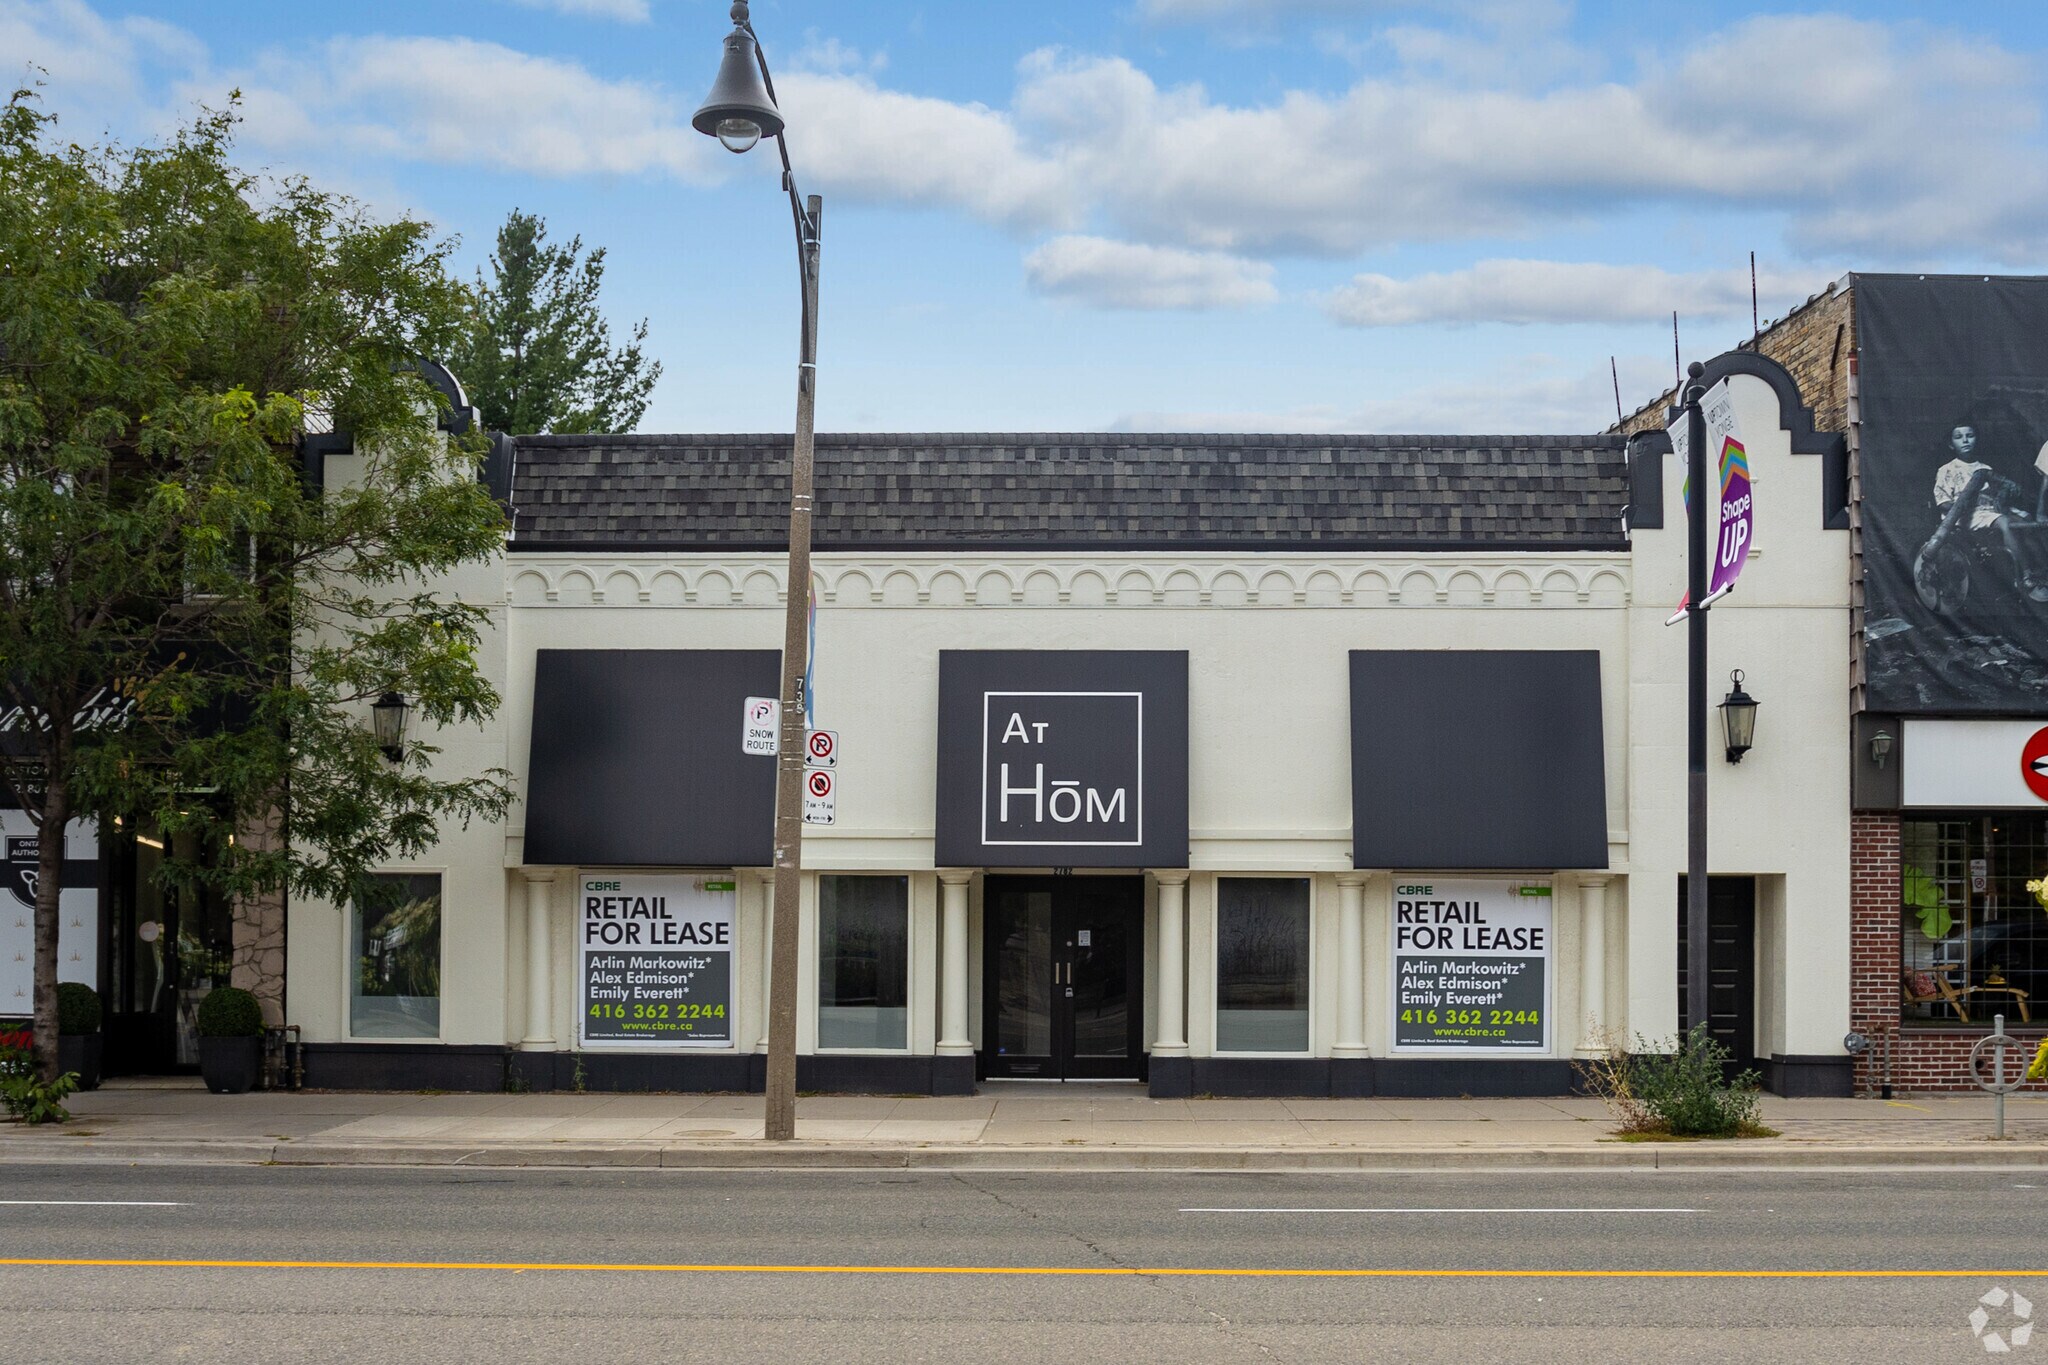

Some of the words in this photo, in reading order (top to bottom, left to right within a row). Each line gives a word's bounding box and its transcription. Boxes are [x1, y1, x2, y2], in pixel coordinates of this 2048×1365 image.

[1722, 494, 1751, 523] Shape
[1721, 518, 1749, 568] UP
[749, 729, 774, 739] SNOW
[747, 740, 775, 751] ROUTE
[585, 881, 621, 891] CBRE
[1397, 885, 1433, 895] CBRE
[586, 897, 673, 920] RETAIL
[1397, 901, 1486, 924] RETAIL
[586, 922, 641, 945] FOR
[650, 922, 729, 945] LEASE
[1397, 926, 1454, 950] FOR
[1463, 927, 1544, 950] LEASE
[590, 956, 625, 969] Arlin
[1401, 961, 1437, 974] Arlin
[590, 971, 622, 984] Alex
[1401, 976, 1434, 989] Alex
[590, 986, 630, 1001] Emily
[1402, 992, 1442, 1007] Emily
[589, 1004, 625, 1018] 416
[633, 1004, 669, 1018] 362
[677, 1004, 725, 1018] 2244
[1401, 1009, 1438, 1024] 416
[1446, 1010, 1481, 1024] 362
[1490, 1010, 1539, 1025] 2244
[621, 1021, 693, 1031] www.cbre.ca
[1434, 1027, 1506, 1037] www.cbre.ca
